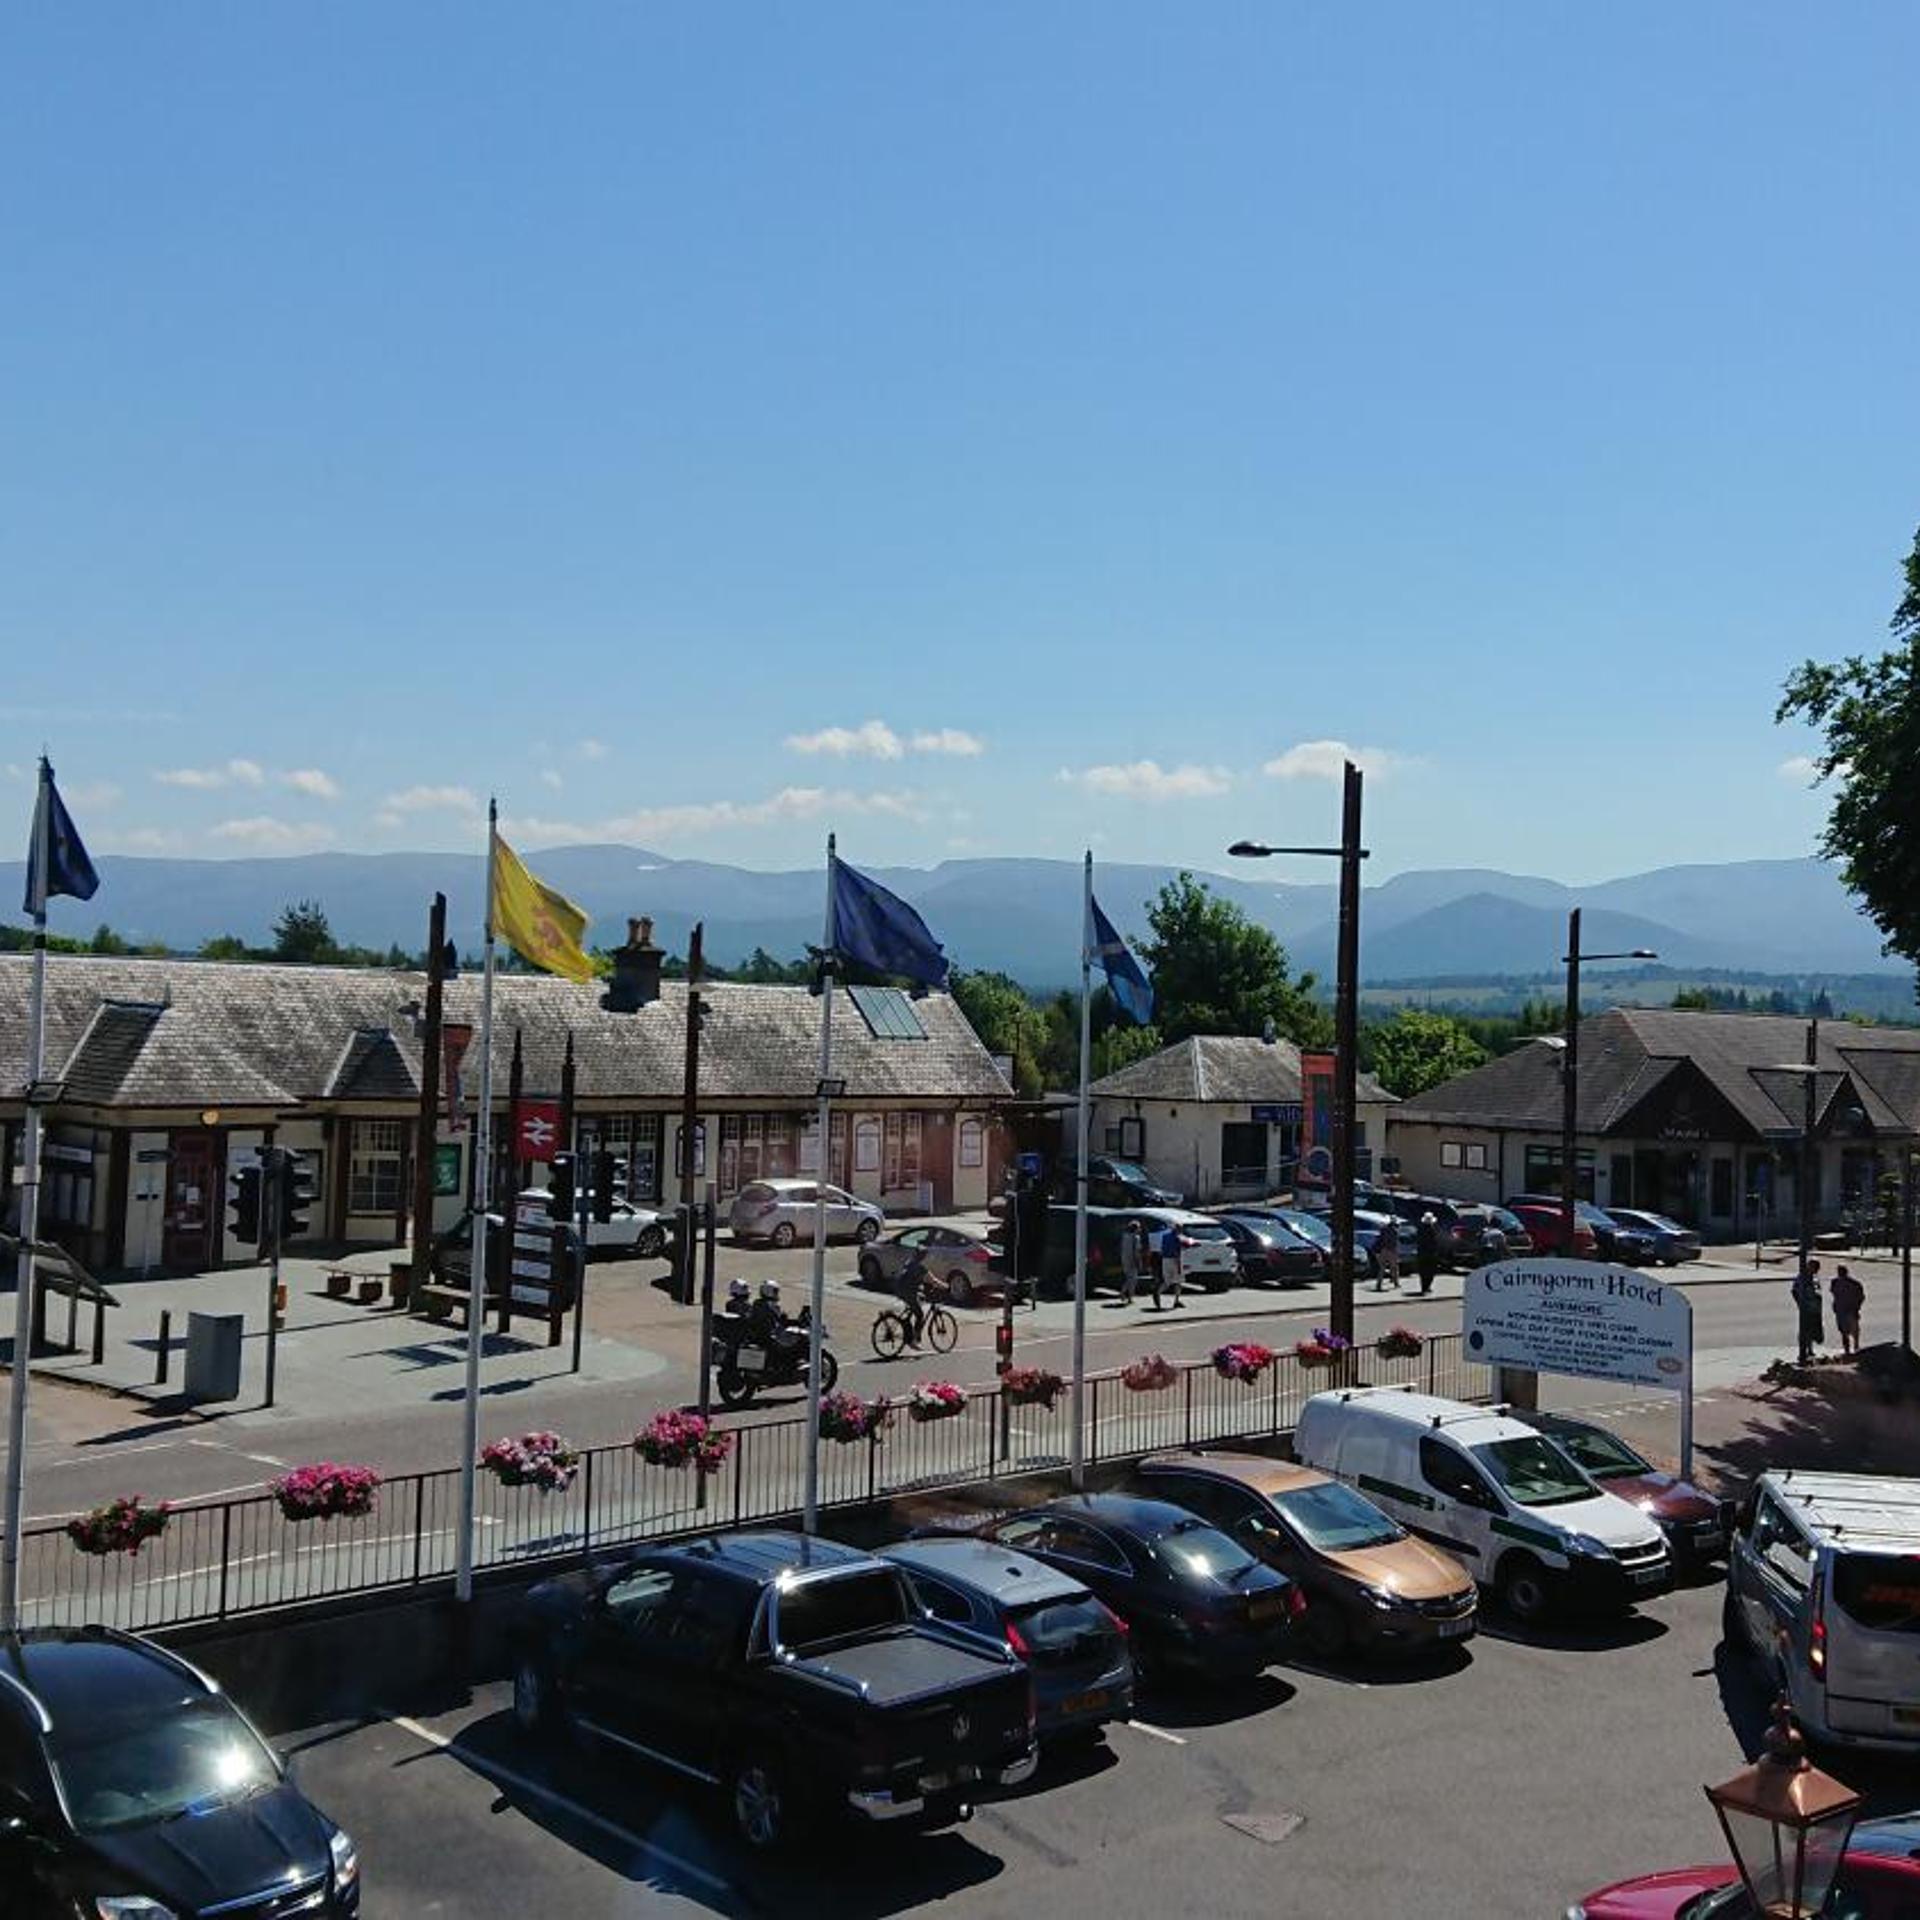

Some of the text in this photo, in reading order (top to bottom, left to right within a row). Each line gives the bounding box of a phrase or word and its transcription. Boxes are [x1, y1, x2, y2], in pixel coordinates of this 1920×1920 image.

[1485, 1266, 1662, 1306] Cairngorm Hotel
[1528, 1323, 1550, 1333] DAY
